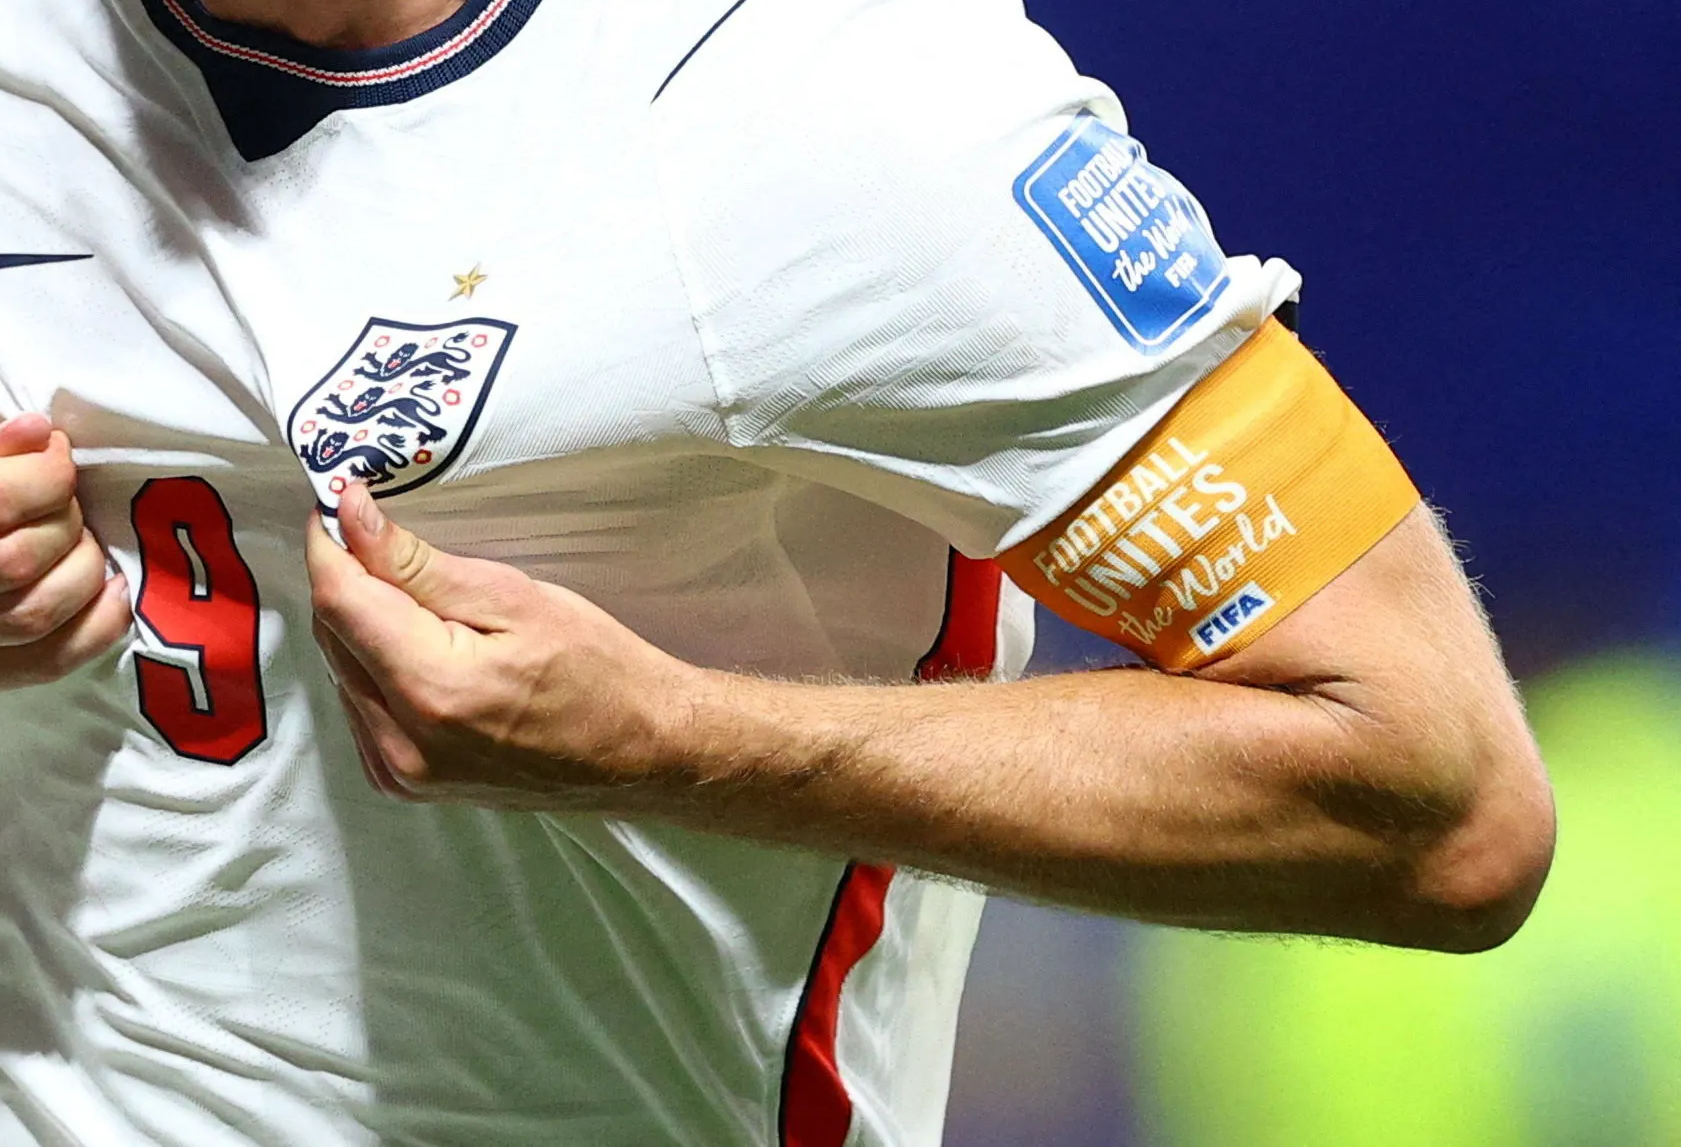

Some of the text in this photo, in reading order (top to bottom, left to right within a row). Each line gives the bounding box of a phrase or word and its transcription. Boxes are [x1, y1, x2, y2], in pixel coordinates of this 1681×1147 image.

[1080, 160, 1166, 252] UNITES
[1112, 249, 1156, 292] the
[1164, 252, 1198, 288] FIFA
[1033, 437, 1208, 586] FOOTBALL
[1065, 463, 1248, 617] UNITES
[1117, 494, 1297, 646] the World
[131, 475, 267, 767] 9
[1196, 594, 1265, 647] FIFA
